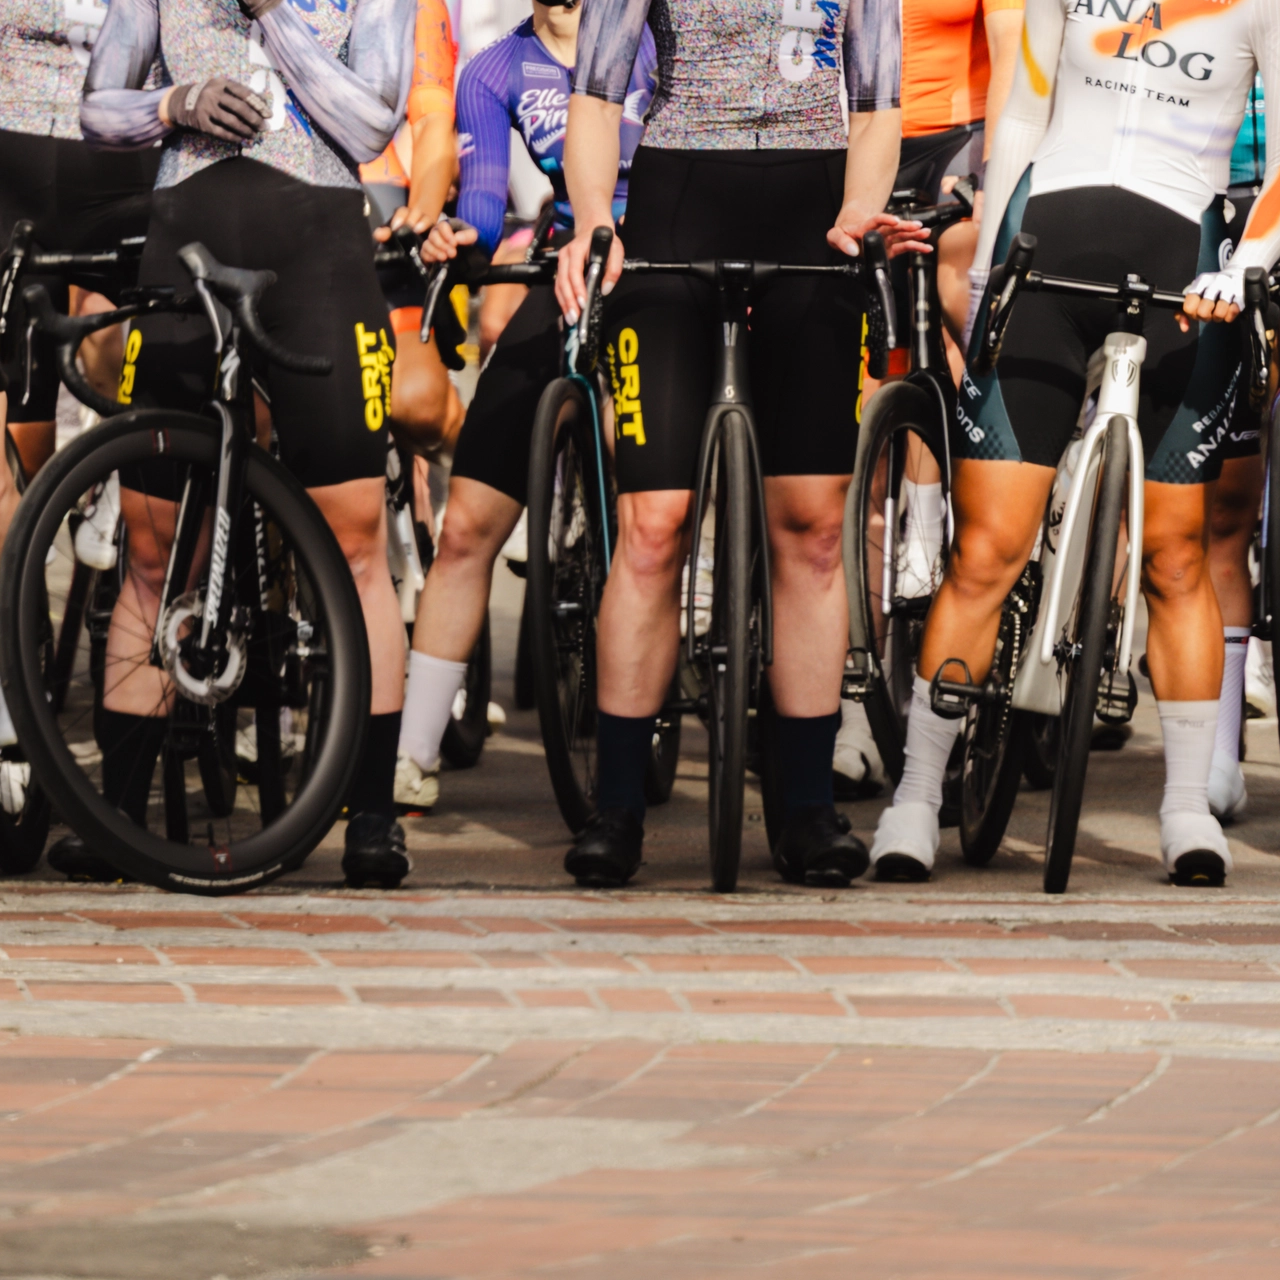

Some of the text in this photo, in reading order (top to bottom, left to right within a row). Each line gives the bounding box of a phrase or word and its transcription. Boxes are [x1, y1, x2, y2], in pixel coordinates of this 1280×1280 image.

[1084, 76, 1190, 108] RACING TEAM
[1112, 31, 1216, 82] LOG
[517, 87, 570, 113] Elle
[354, 321, 387, 432] CRIT
[618, 327, 647, 446] CRIT
[203, 504, 231, 629] SPECIALIZED
